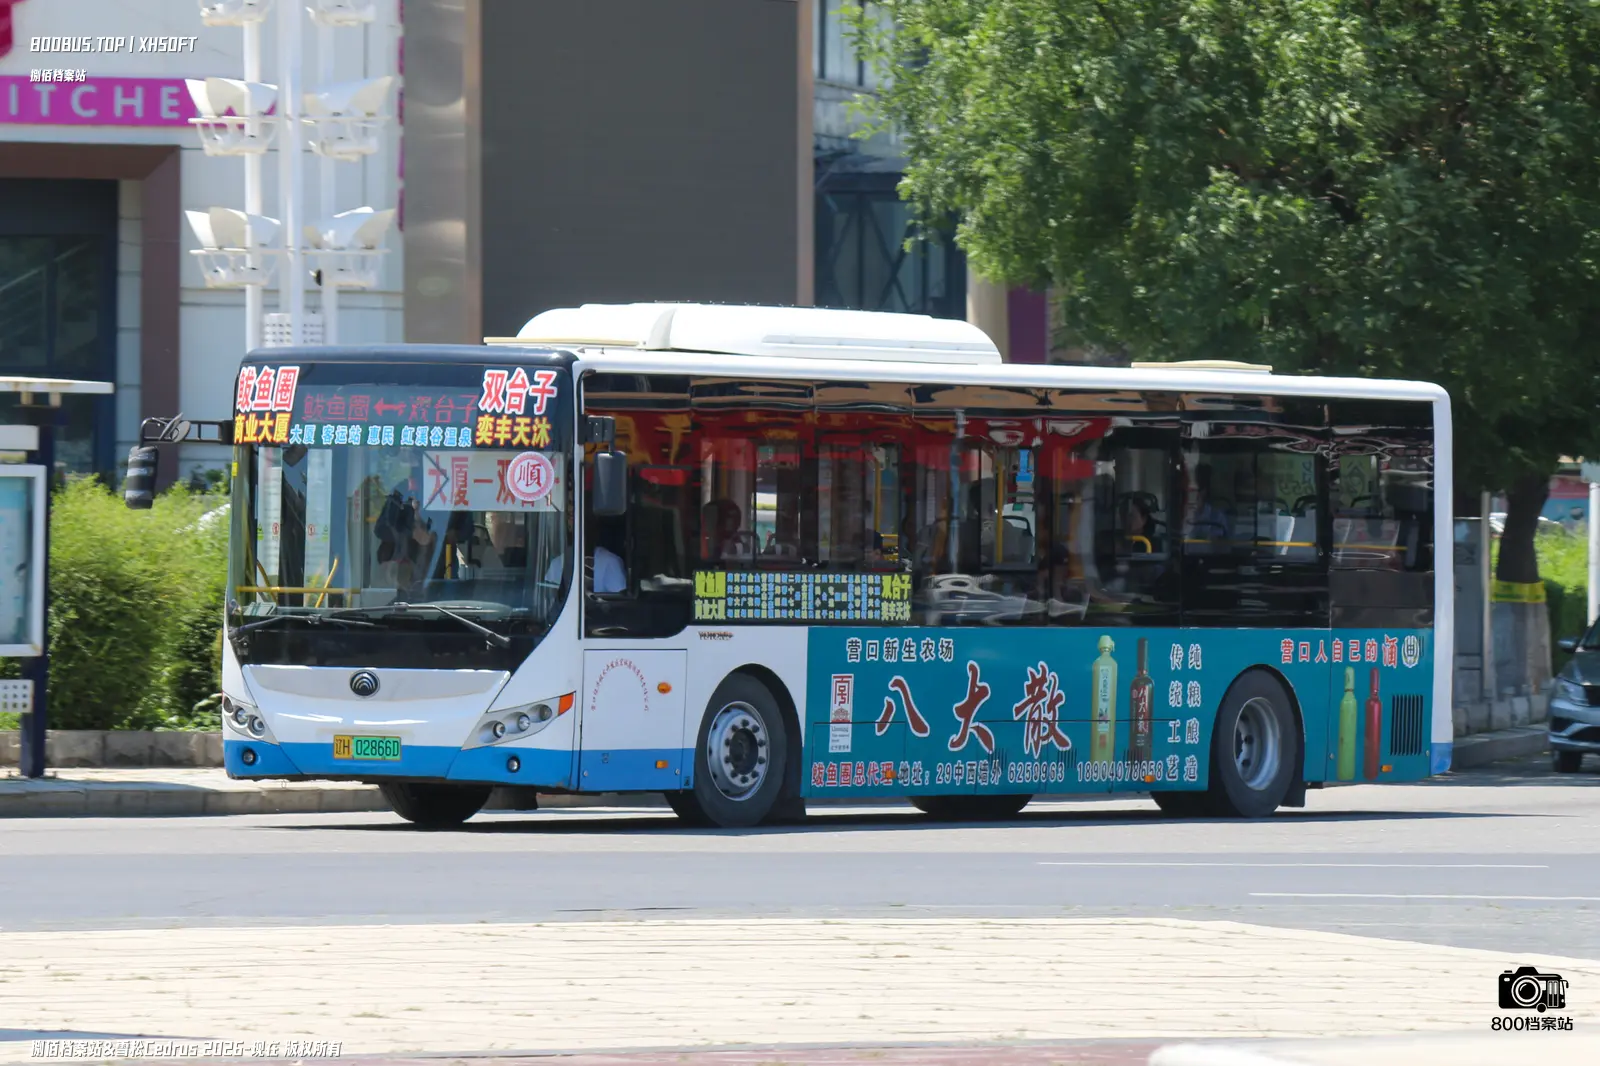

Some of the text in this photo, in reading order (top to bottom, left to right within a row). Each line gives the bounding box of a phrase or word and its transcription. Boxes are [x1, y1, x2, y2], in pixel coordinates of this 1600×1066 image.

[236, 366, 300, 412] 鲅鱼圈
[478, 367, 558, 415] 双台子
[234, 412, 291, 444] 商业大厦
[290, 425, 316, 445] 大厦
[322, 425, 362, 445] 客运站
[846, 637, 955, 663] 营口新生农场
[875, 659, 1072, 759] 八大散
[355, 739, 400, 757] 02866D
